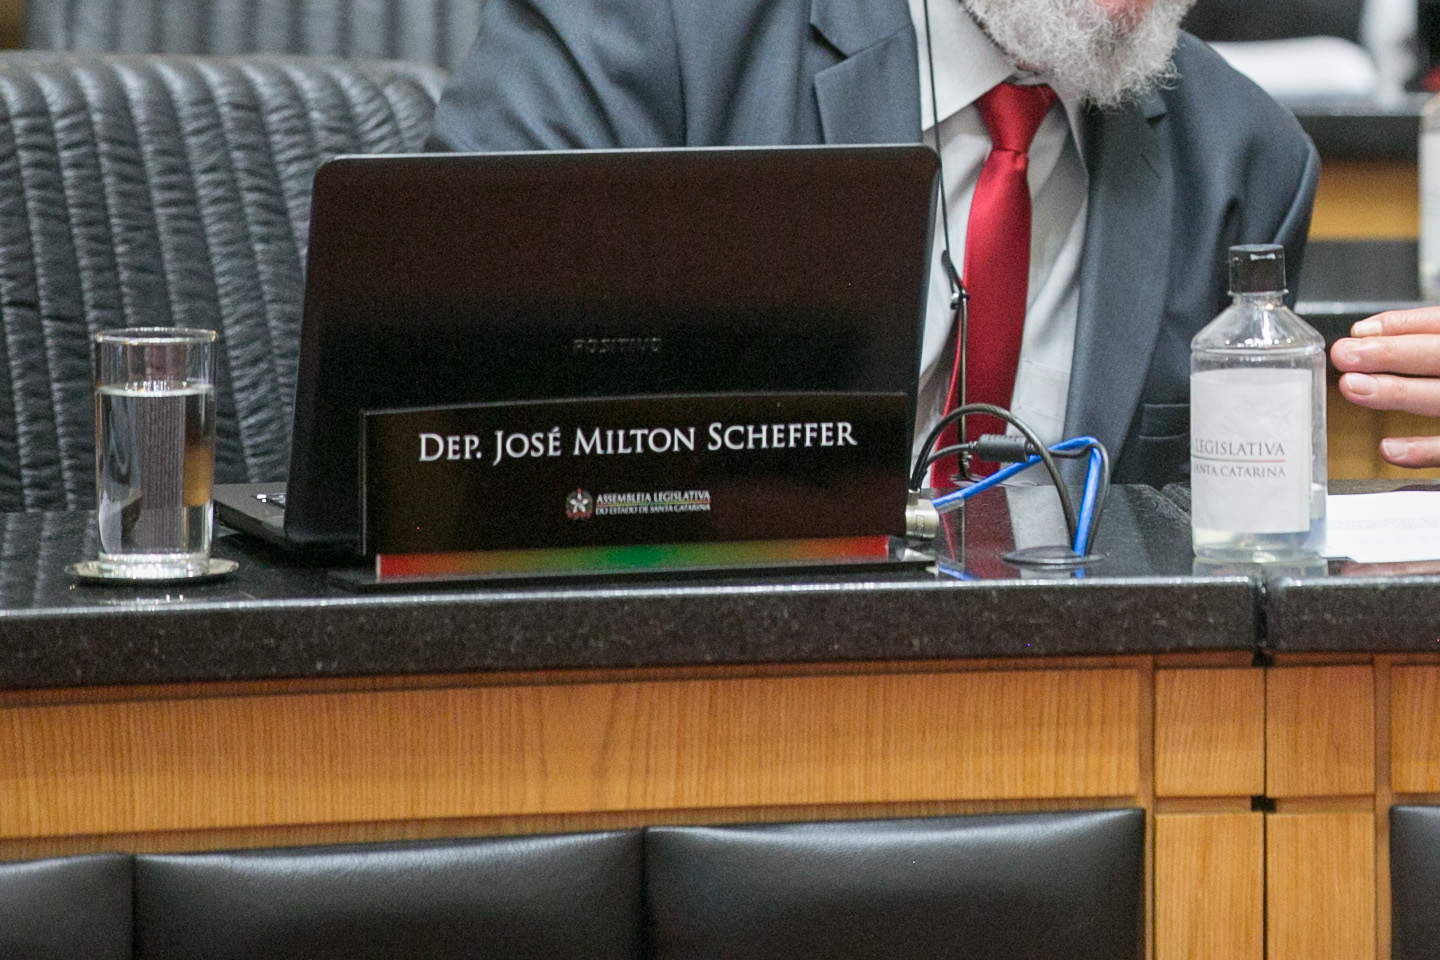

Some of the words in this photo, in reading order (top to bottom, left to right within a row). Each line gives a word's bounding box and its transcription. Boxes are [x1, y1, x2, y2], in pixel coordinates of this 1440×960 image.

[419, 433, 482, 461] DEP.
[493, 426, 562, 466] JOSÉ
[573, 426, 696, 456] MILTON
[707, 421, 858, 451] SCHEFFER
[1195, 438, 1286, 456] LEGISLATIVA
[1220, 465, 1286, 478] CATARINA
[596, 492, 651, 504] ASSEMBLEIA
[653, 490, 710, 502] LEGISLATIVA
